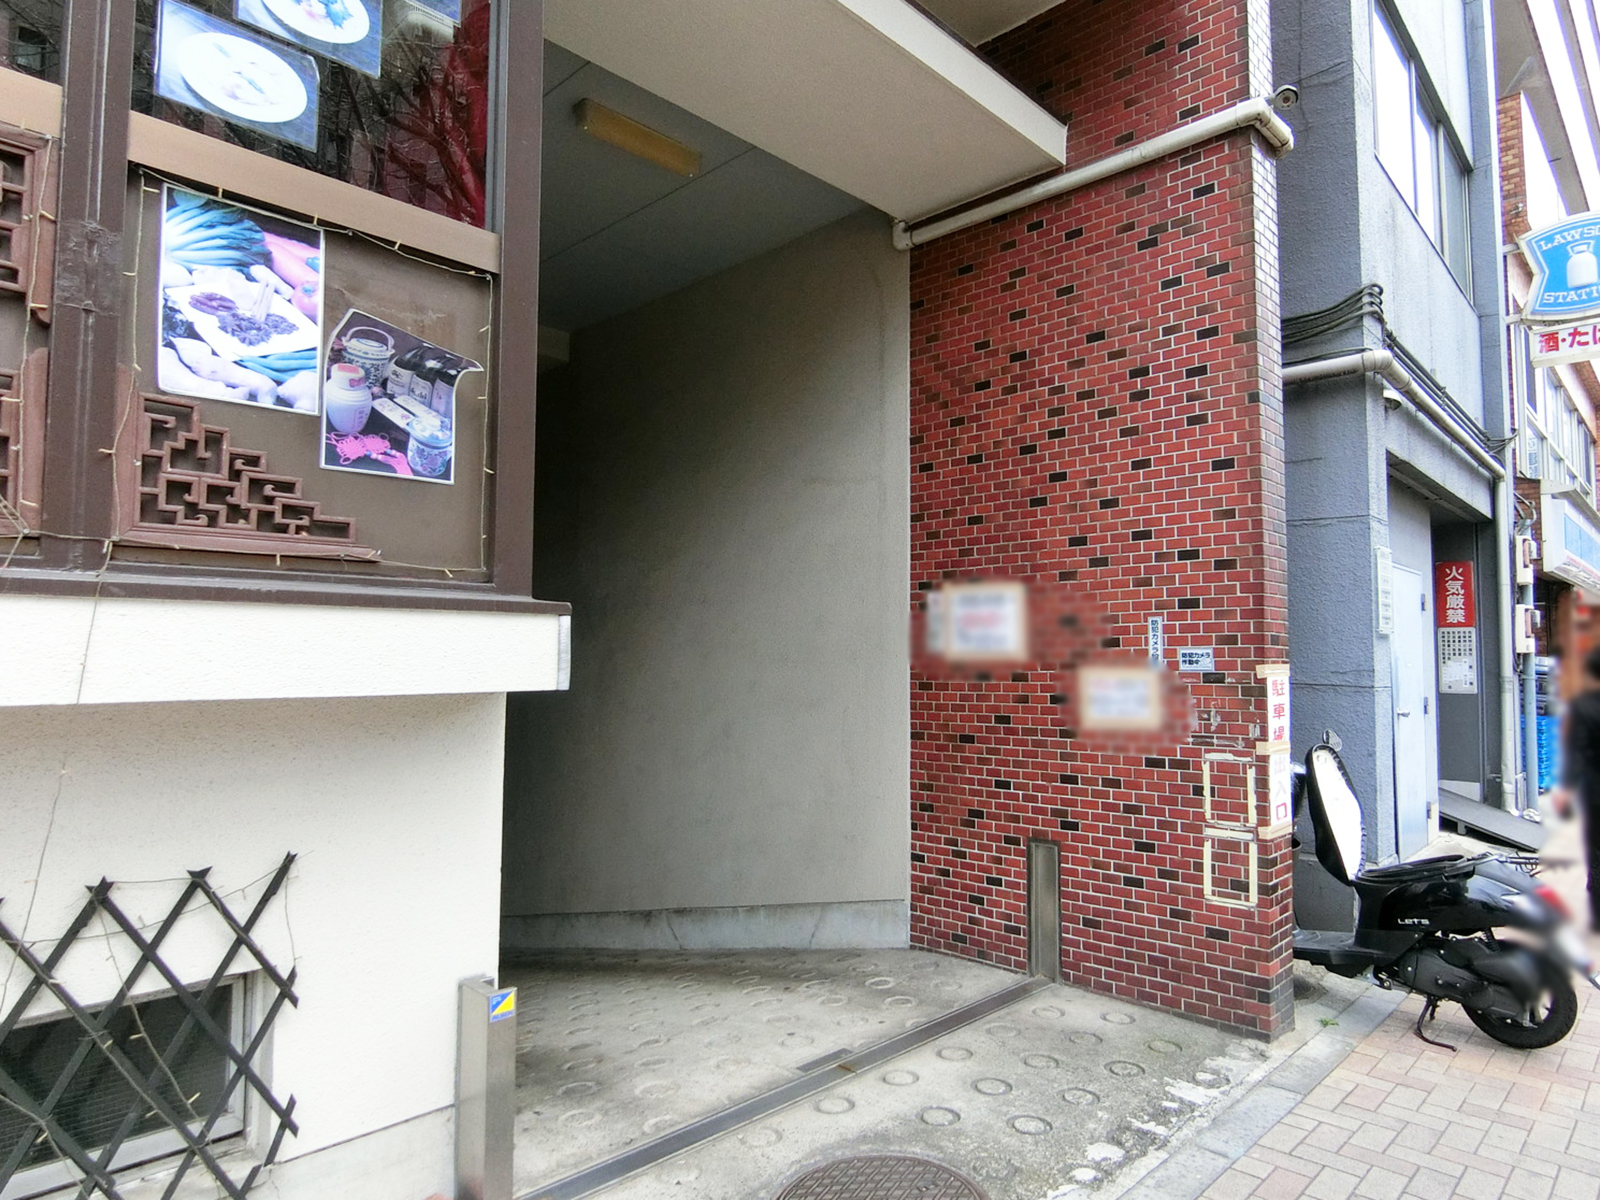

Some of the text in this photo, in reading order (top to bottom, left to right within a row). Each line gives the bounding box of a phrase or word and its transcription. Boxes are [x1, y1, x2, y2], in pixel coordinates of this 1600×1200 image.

[1543, 285, 1600, 303] STATI
[1444, 565, 1466, 623] 火気厳禁
[1181, 651, 1211, 659] 防犯カメラ
[1271, 679, 1286, 743] 駐車場
[1273, 755, 1288, 822] 出入口
